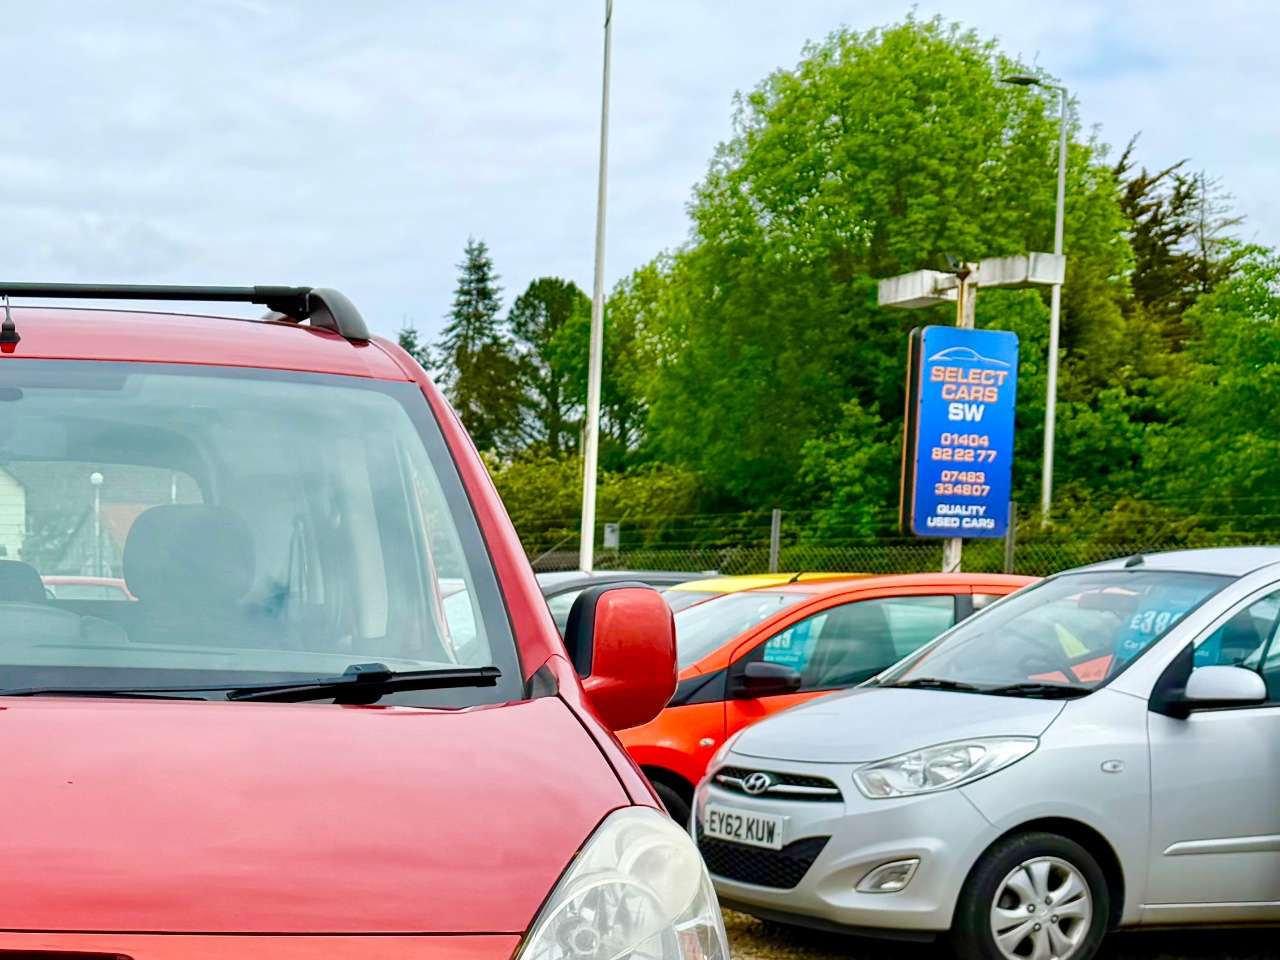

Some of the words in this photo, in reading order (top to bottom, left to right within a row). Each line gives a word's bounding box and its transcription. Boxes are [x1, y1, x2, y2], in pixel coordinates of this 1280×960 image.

[930, 366, 1008, 385] SELECT
[941, 384, 998, 403] CARS
[948, 402, 984, 422] SW
[940, 432, 989, 447] 01404
[941, 470, 985, 484] 07483
[934, 482, 991, 496] 334807
[936, 503, 986, 516] QUALITY
[927, 516, 960, 528] USED
[961, 517, 995, 529] CARS
[1129, 605, 1185, 631] £38
[709, 811, 743, 837] EY62
[745, 817, 776, 844] KUW
